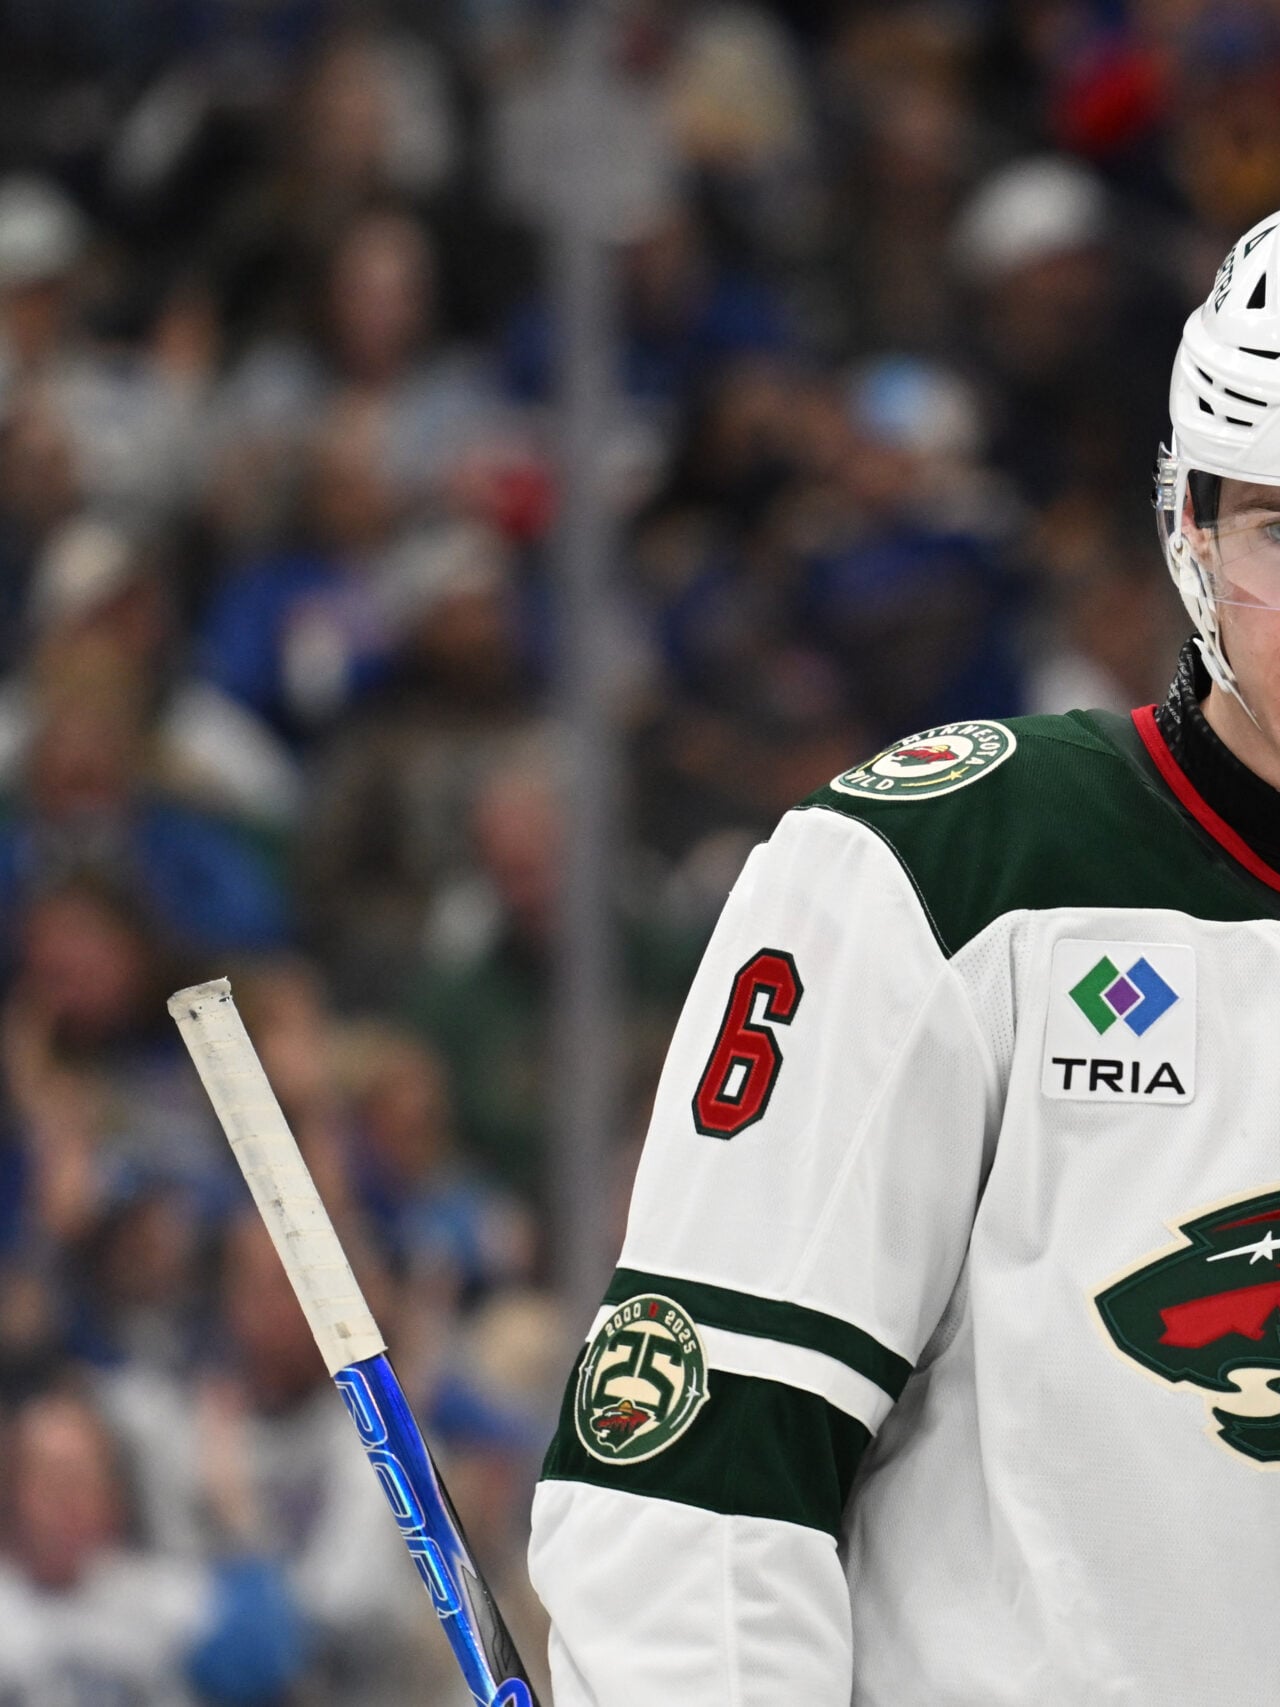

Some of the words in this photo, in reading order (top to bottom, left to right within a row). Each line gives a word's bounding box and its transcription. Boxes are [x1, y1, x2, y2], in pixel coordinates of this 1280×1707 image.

[901, 724, 1001, 766] MINNESOTA
[844, 769, 895, 791] WILD
[691, 947, 805, 1141] 6
[1052, 1057, 1186, 1095] TRIA
[604, 1302, 642, 1337] 2000
[663, 1310, 698, 1354] 2025
[592, 1329, 684, 1423] 25
